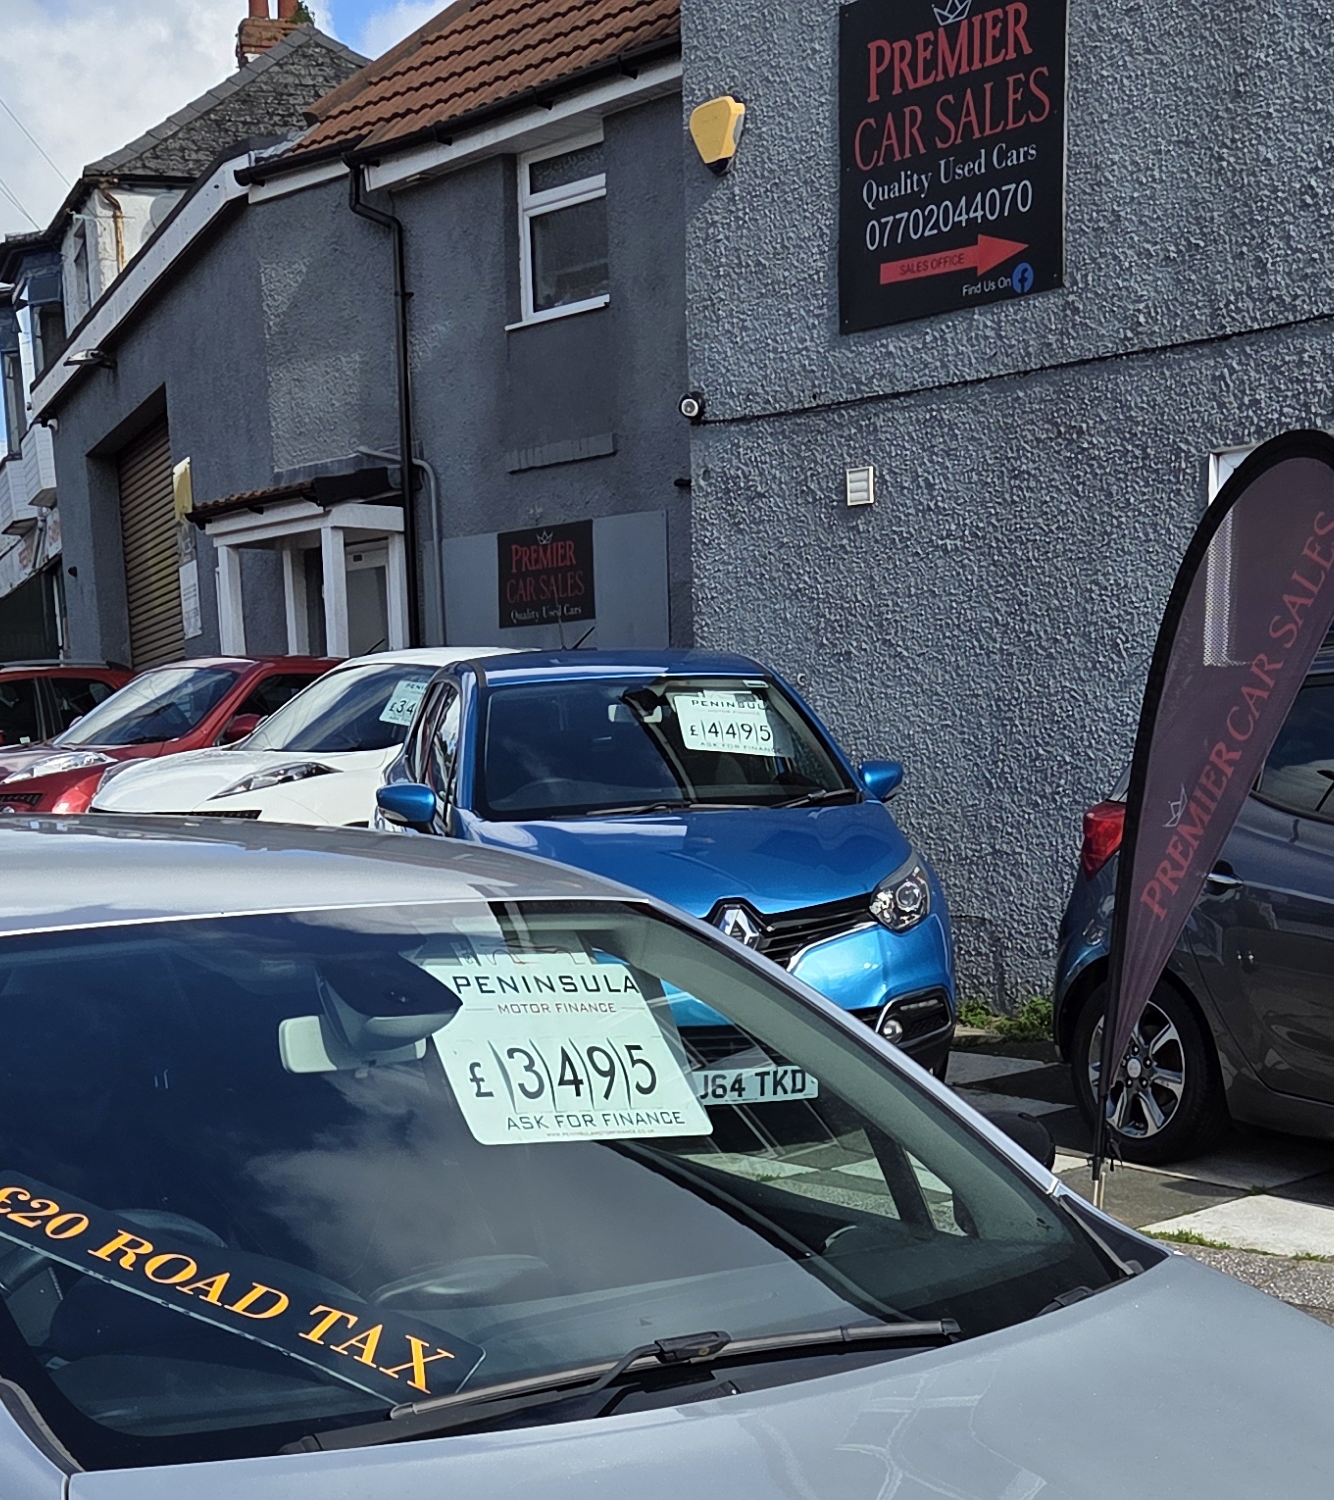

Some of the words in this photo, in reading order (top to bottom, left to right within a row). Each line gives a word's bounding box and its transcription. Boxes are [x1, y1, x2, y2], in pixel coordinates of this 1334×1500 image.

[867, 2, 1033, 103] PREMIER
[854, 105, 926, 171] CAR
[935, 66, 1051, 149] SALES
[862, 169, 932, 210] Quality
[939, 149, 986, 184] Used
[992, 142, 1037, 169] Cars
[866, 179, 1033, 251] 07702044070
[899, 258, 929, 276] SALES
[931, 252, 965, 270] OFFICE
[962, 280, 982, 297] Find
[983, 278, 996, 293] Us
[998, 276, 1011, 289] On
[511, 540, 576, 573] PREMIER
[507, 576, 536, 604] CAR
[539, 570, 585, 600] SALES
[511, 608, 540, 624] Quality
[563, 603, 582, 616] Cars
[1140, 739, 1241, 922] PREMIER
[1226, 652, 1283, 744] CAR
[452, 975, 640, 994] PENINSULA
[497, 1003, 551, 1014] MOTOR
[556, 1002, 617, 1013] FINANCE
[699, 1072, 746, 1100] J64
[754, 1069, 807, 1097] TKD
[507, 1115, 549, 1131] ASK
[554, 1113, 597, 1128] FOR
[604, 1111, 686, 1126] FINANCE
[87, 1228, 290, 1320] ROAD
[298, 1304, 455, 1395] TAX
